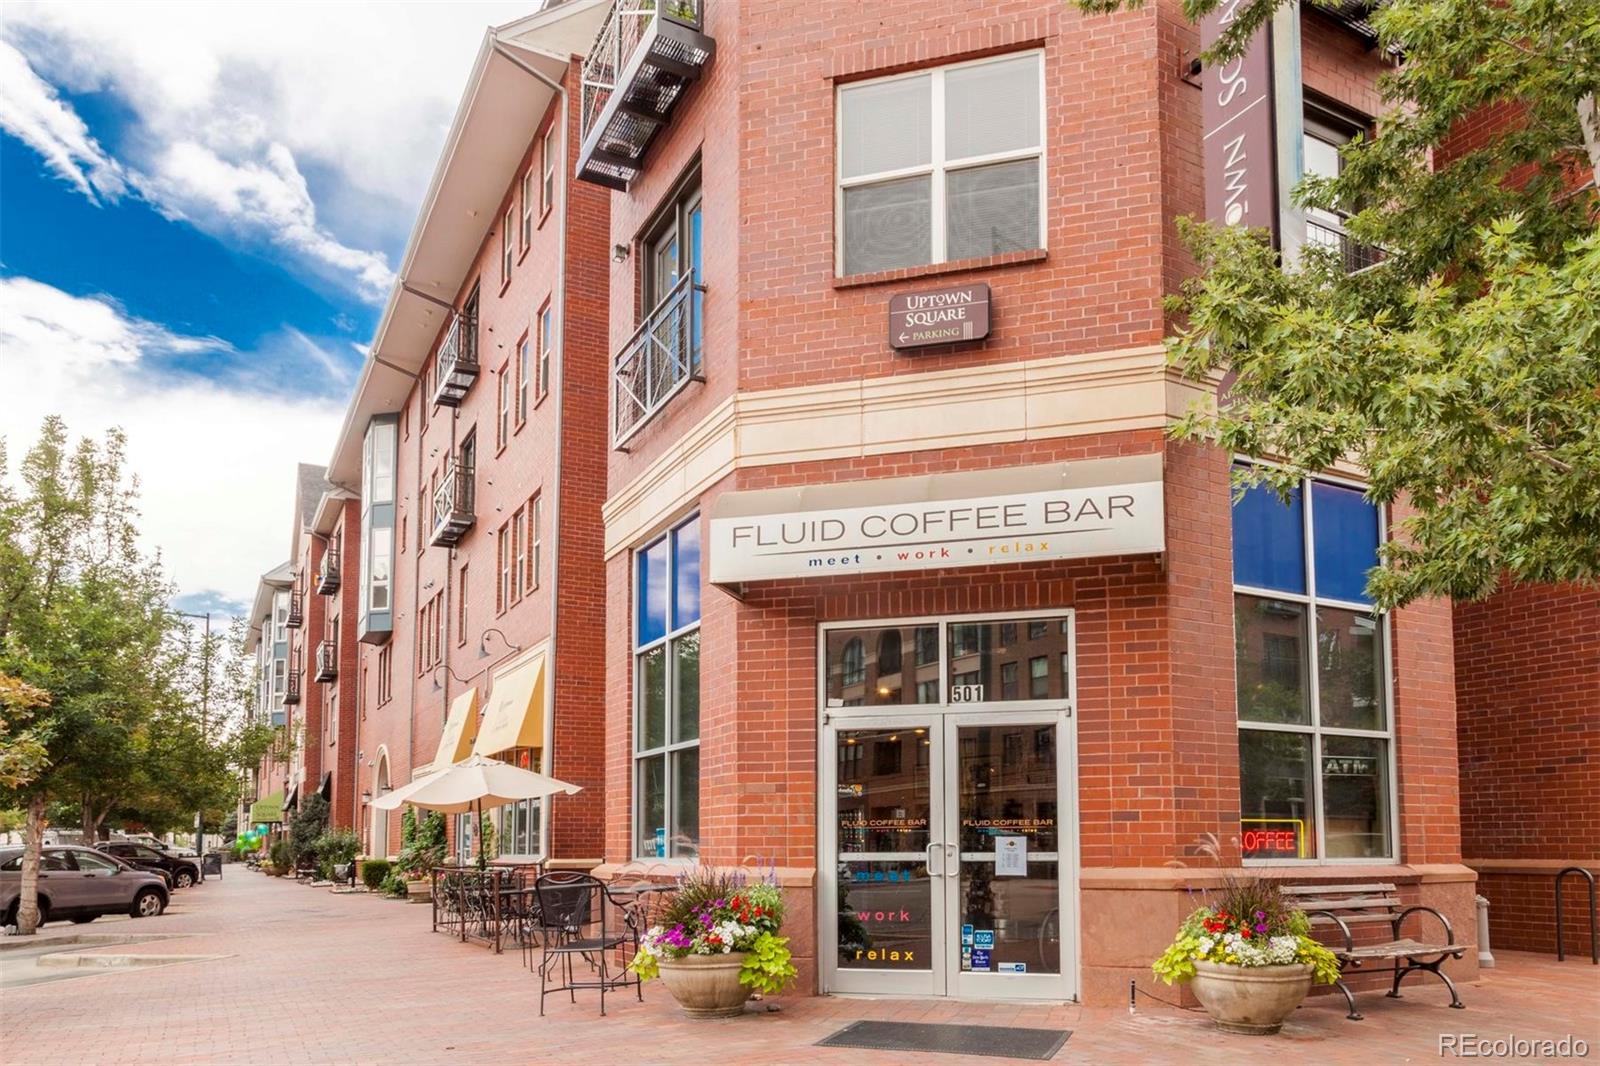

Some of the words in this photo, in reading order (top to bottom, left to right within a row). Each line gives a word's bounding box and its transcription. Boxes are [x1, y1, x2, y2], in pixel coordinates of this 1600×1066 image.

[906, 290, 972, 310] UPTOWN
[905, 307, 966, 327] SQUARE
[912, 327, 960, 341] PARKING
[732, 519, 846, 548] FLUID
[860, 503, 1027, 538] COFFEE
[1044, 494, 1135, 525] BAR
[808, 553, 861, 567] meet
[896, 546, 950, 561] work
[988, 540, 1049, 555] relax
[953, 685, 982, 702] 501
[841, 819, 868, 827] FLUID
[907, 818, 927, 826] BAR
[963, 819, 991, 827] FLUID
[1033, 818, 1054, 826] BAR
[857, 907, 910, 921] work
[856, 948, 914, 961] relax
